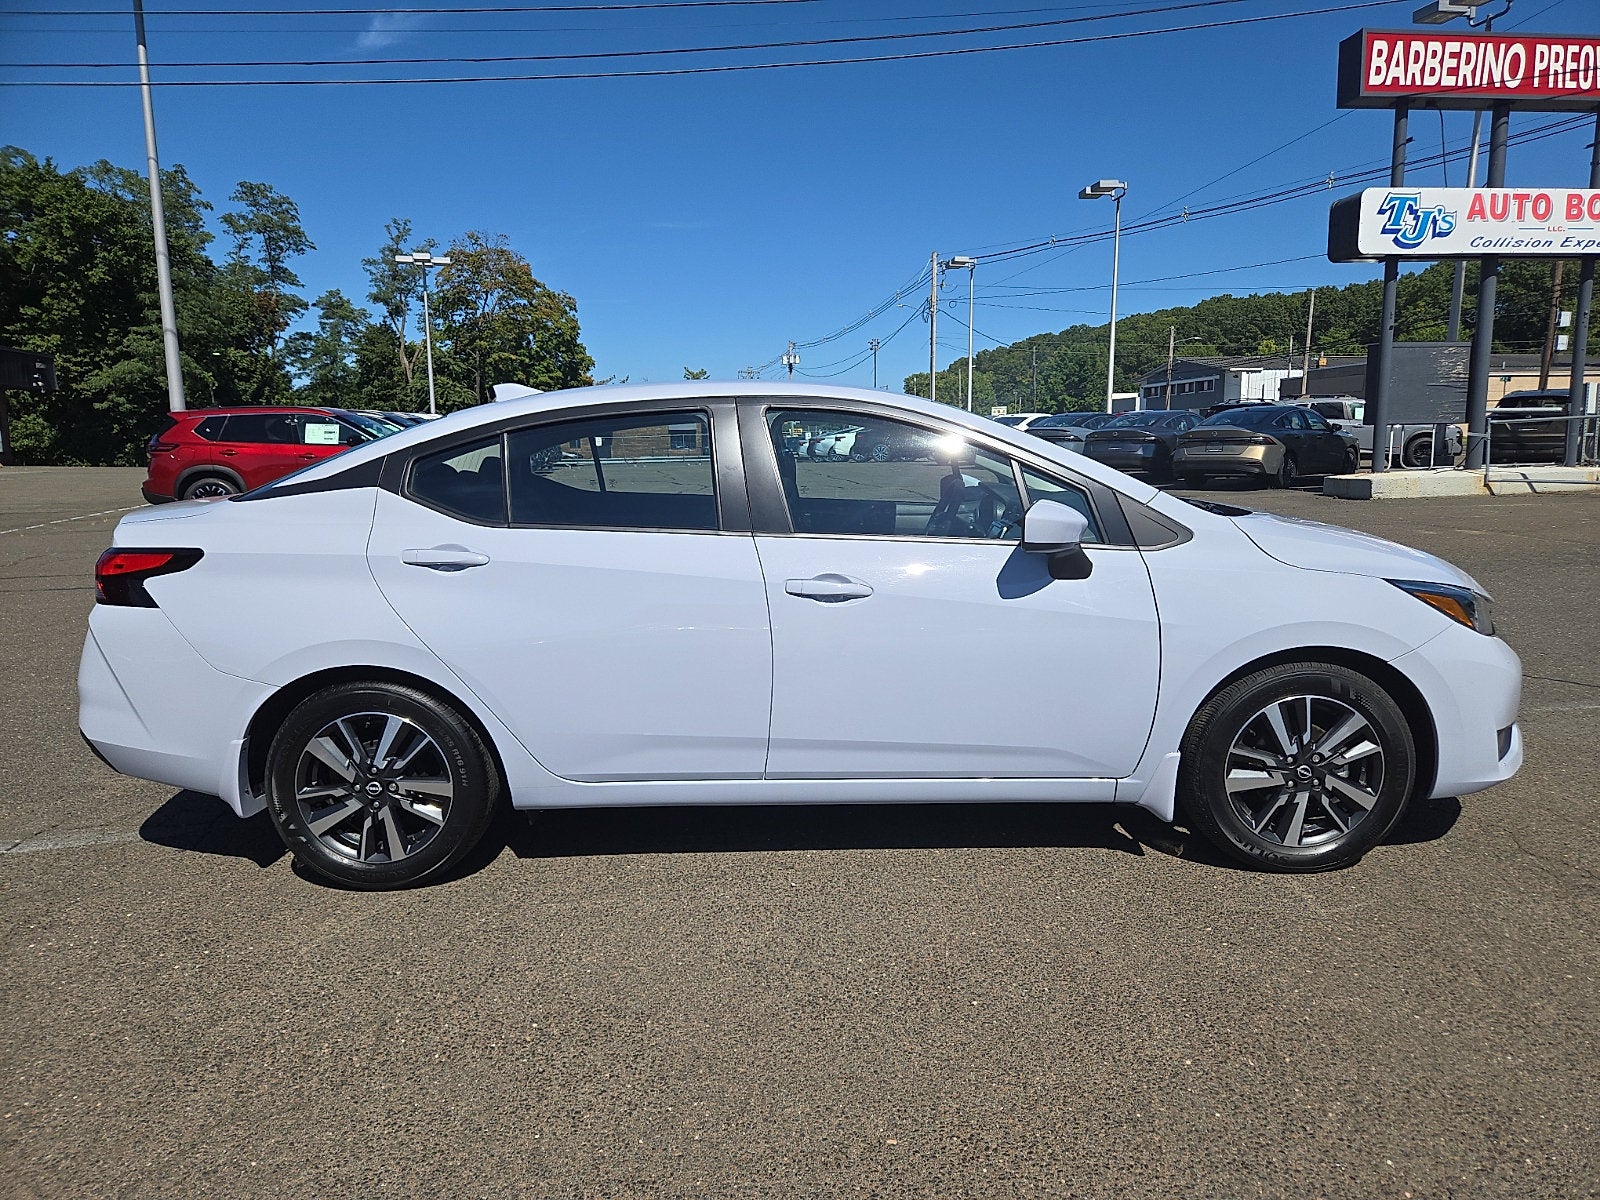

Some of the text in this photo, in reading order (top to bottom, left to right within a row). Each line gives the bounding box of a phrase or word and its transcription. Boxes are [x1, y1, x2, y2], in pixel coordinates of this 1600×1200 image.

[1368, 40, 1600, 90] BARBERINO PREO
[1377, 192, 1457, 249] TJ's
[1466, 193, 1553, 222] AUTO
[1470, 236, 1553, 248] Collision
